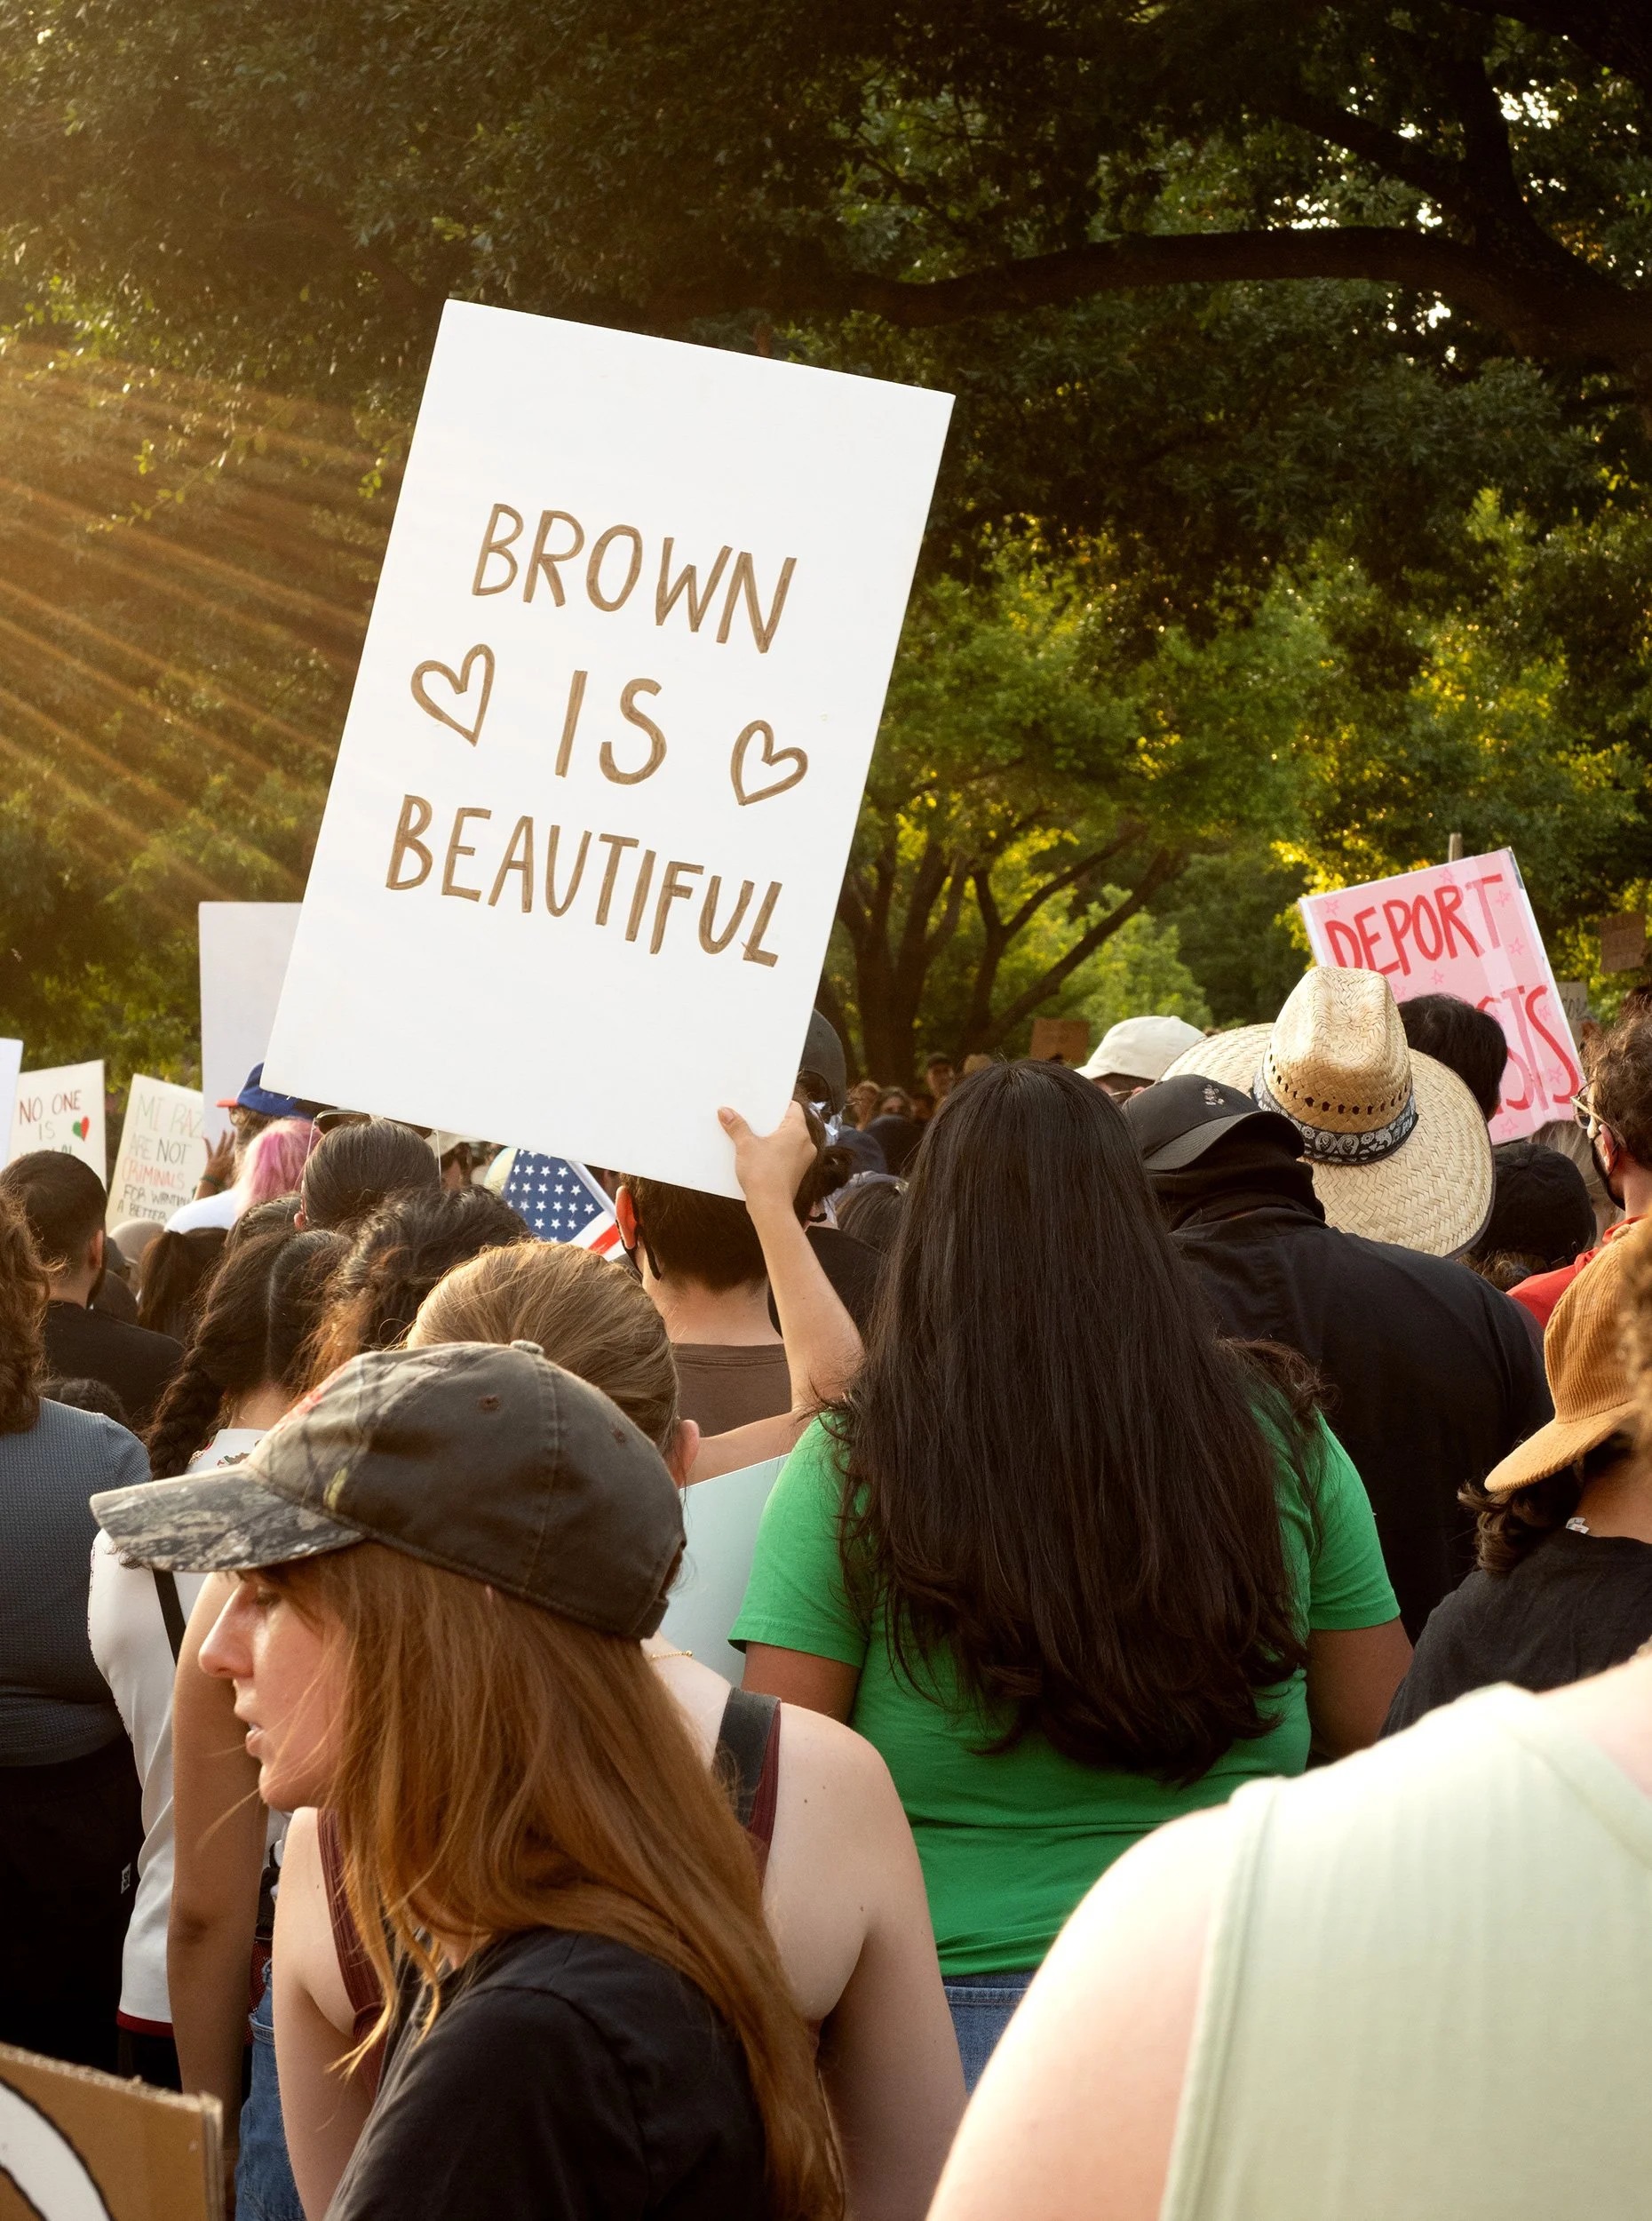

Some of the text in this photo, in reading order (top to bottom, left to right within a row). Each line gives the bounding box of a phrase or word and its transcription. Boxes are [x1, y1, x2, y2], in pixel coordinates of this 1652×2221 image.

[472, 503, 798, 654] BROWN
[555, 669, 668, 785] IS
[385, 793, 783, 967] BEAUTIFUL
[1324, 873, 1503, 976] DEPORT
[20, 1089, 82, 1126] NO ONE
[170, 1102, 204, 1138] RAZ
[38, 1120, 55, 1142] IS
[128, 1131, 193, 1165] ARE NOT
[122, 1156, 186, 1191] CRIMINALS
[116, 1198, 168, 1224] A BETTER
[123, 1183, 192, 1207] FOR WANTIN
